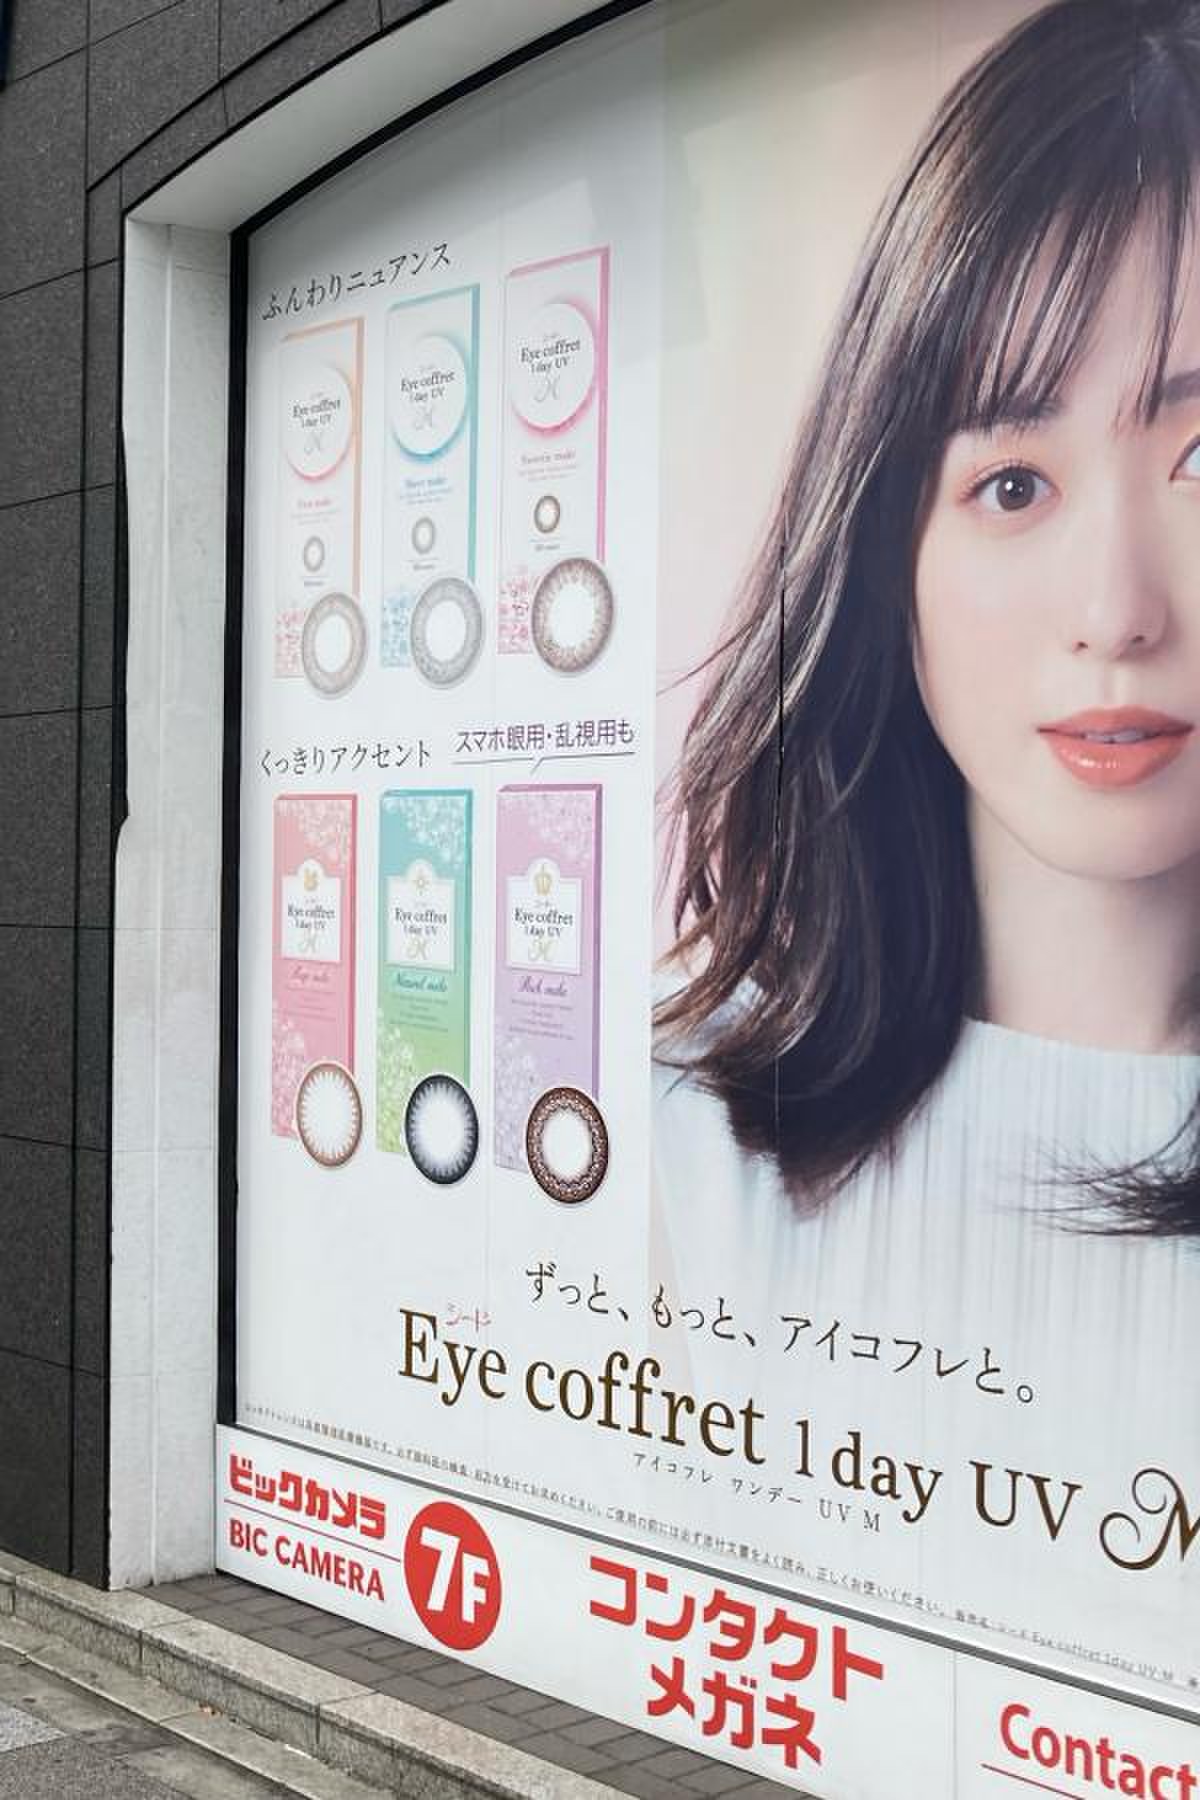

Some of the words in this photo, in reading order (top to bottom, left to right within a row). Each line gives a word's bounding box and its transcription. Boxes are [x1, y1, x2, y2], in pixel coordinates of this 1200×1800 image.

[261, 242, 452, 322] ふんわりニュアンス
[521, 346, 541, 364] Eye
[543, 338, 581, 359] coffret
[554, 356, 570, 370] UV
[259, 739, 432, 776] くっきりアクセント
[515, 906, 534, 926] Eye
[535, 908, 574, 927] coffret
[398, 1307, 507, 1406] Eye
[525, 1350, 766, 1466] coffret
[968, 1460, 1083, 1541] UV
[229, 1453, 387, 1541] ビックカメラ
[632, 1452, 714, 1484] アイコフレ
[732, 1477, 801, 1505] ワンデー
[819, 1499, 851, 1522] UV
[228, 1518, 269, 1558] BIC
[274, 1535, 386, 1603] CAMERA
[419, 1526, 490, 1624] 7F
[589, 1554, 885, 1702] コンタクト
[645, 1655, 823, 1770] メガネ
[1000, 1702, 1199, 1800] Contact
